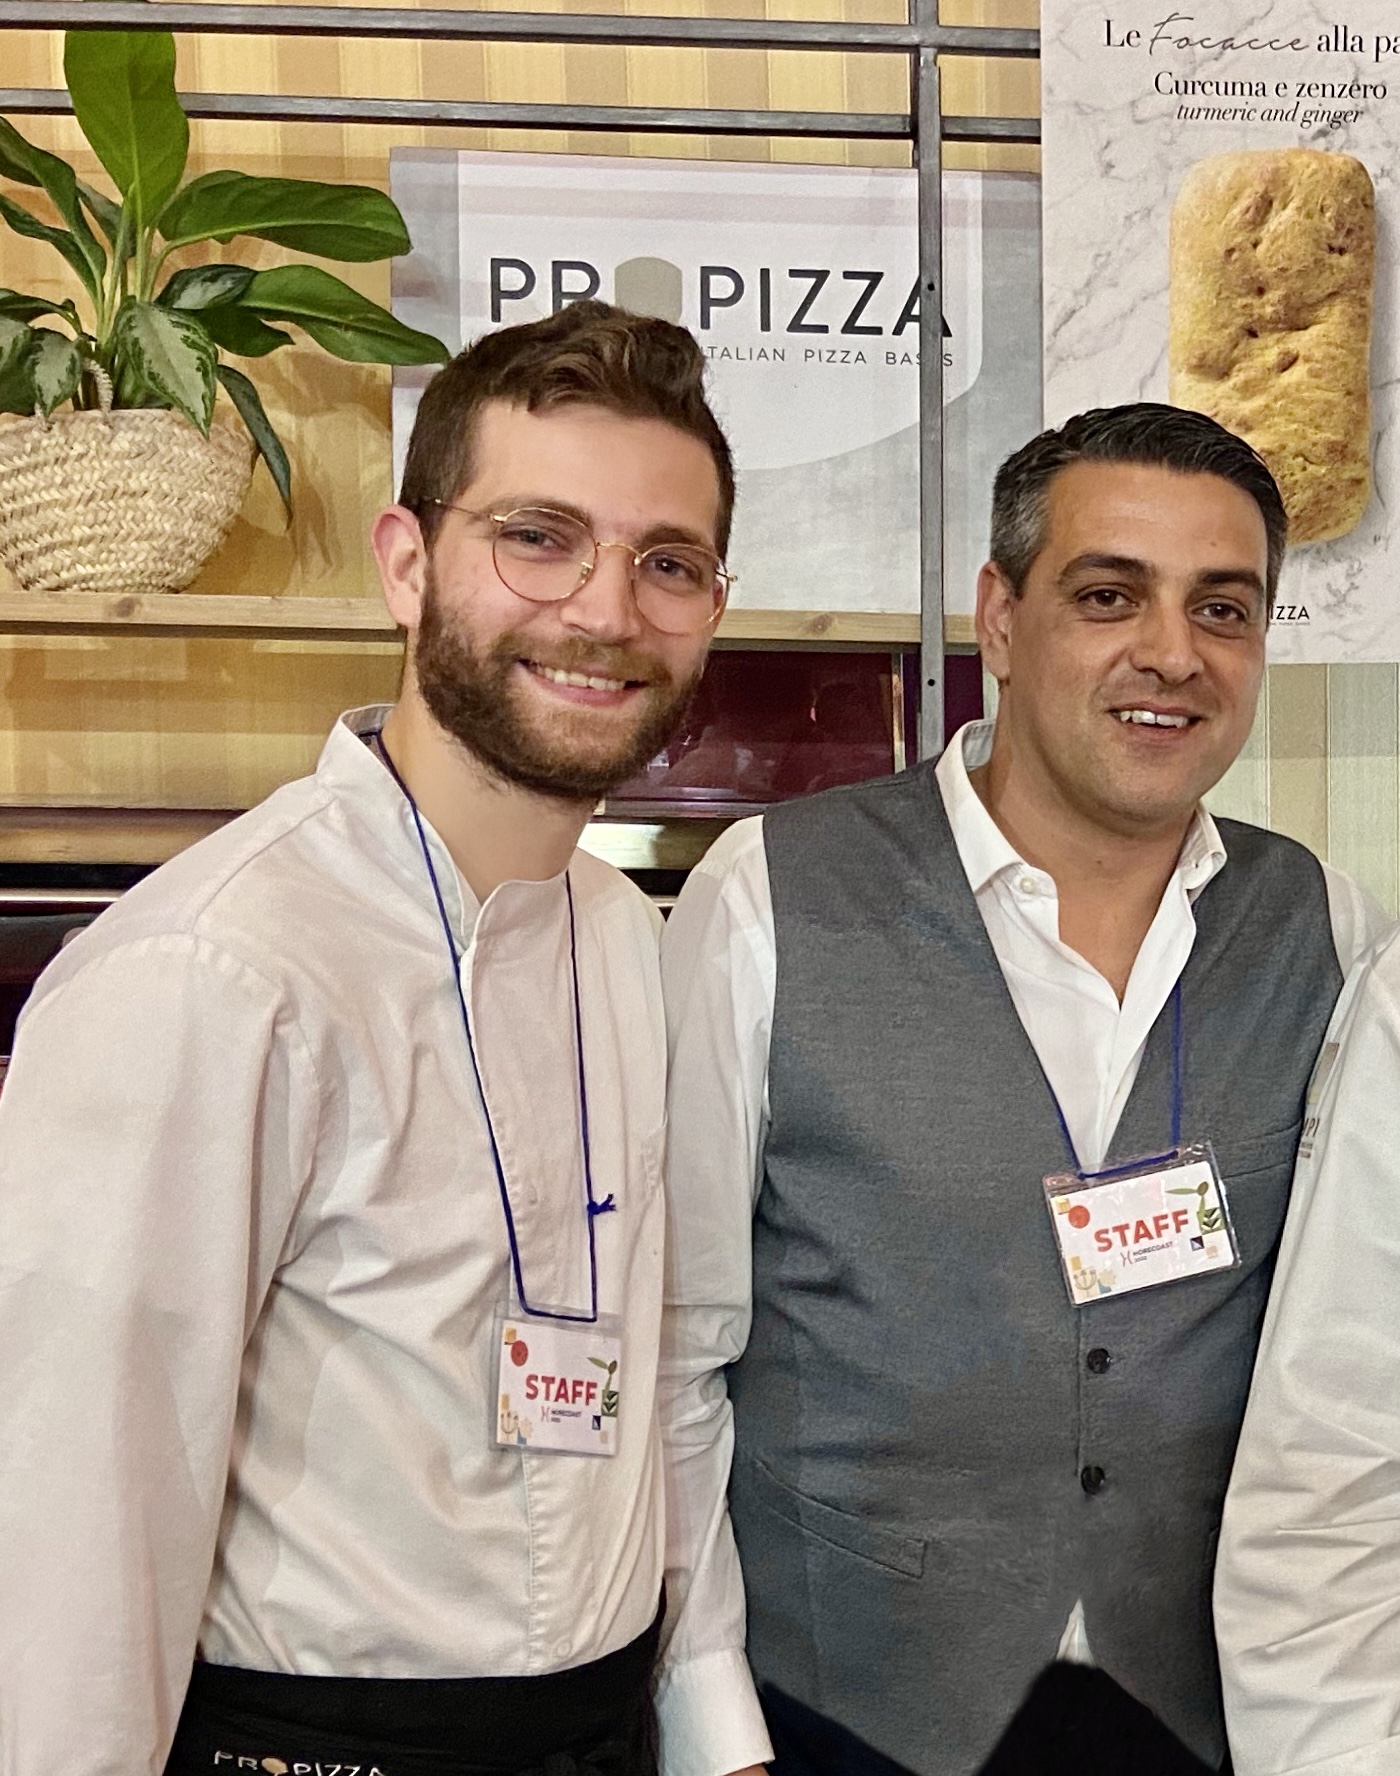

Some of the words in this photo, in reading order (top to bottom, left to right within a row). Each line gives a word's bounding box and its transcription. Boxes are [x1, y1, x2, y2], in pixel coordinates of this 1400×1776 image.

[1103, 19, 1141, 48] Le
[1149, 12, 1310, 56] Focacce
[1317, 25, 1365, 53] alla
[1154, 70, 1267, 98] Curcuma
[1275, 82, 1289, 99] e
[1176, 103, 1257, 122] turmeric
[1260, 101, 1300, 122] and
[1301, 106, 1365, 129] ginger
[700, 346, 786, 362] ITALIAN
[803, 349, 867, 365] PIZZA
[885, 352, 953, 367] BAS
[1094, 1208, 1189, 1252] STAFF
[525, 1373, 598, 1406] STAFF
